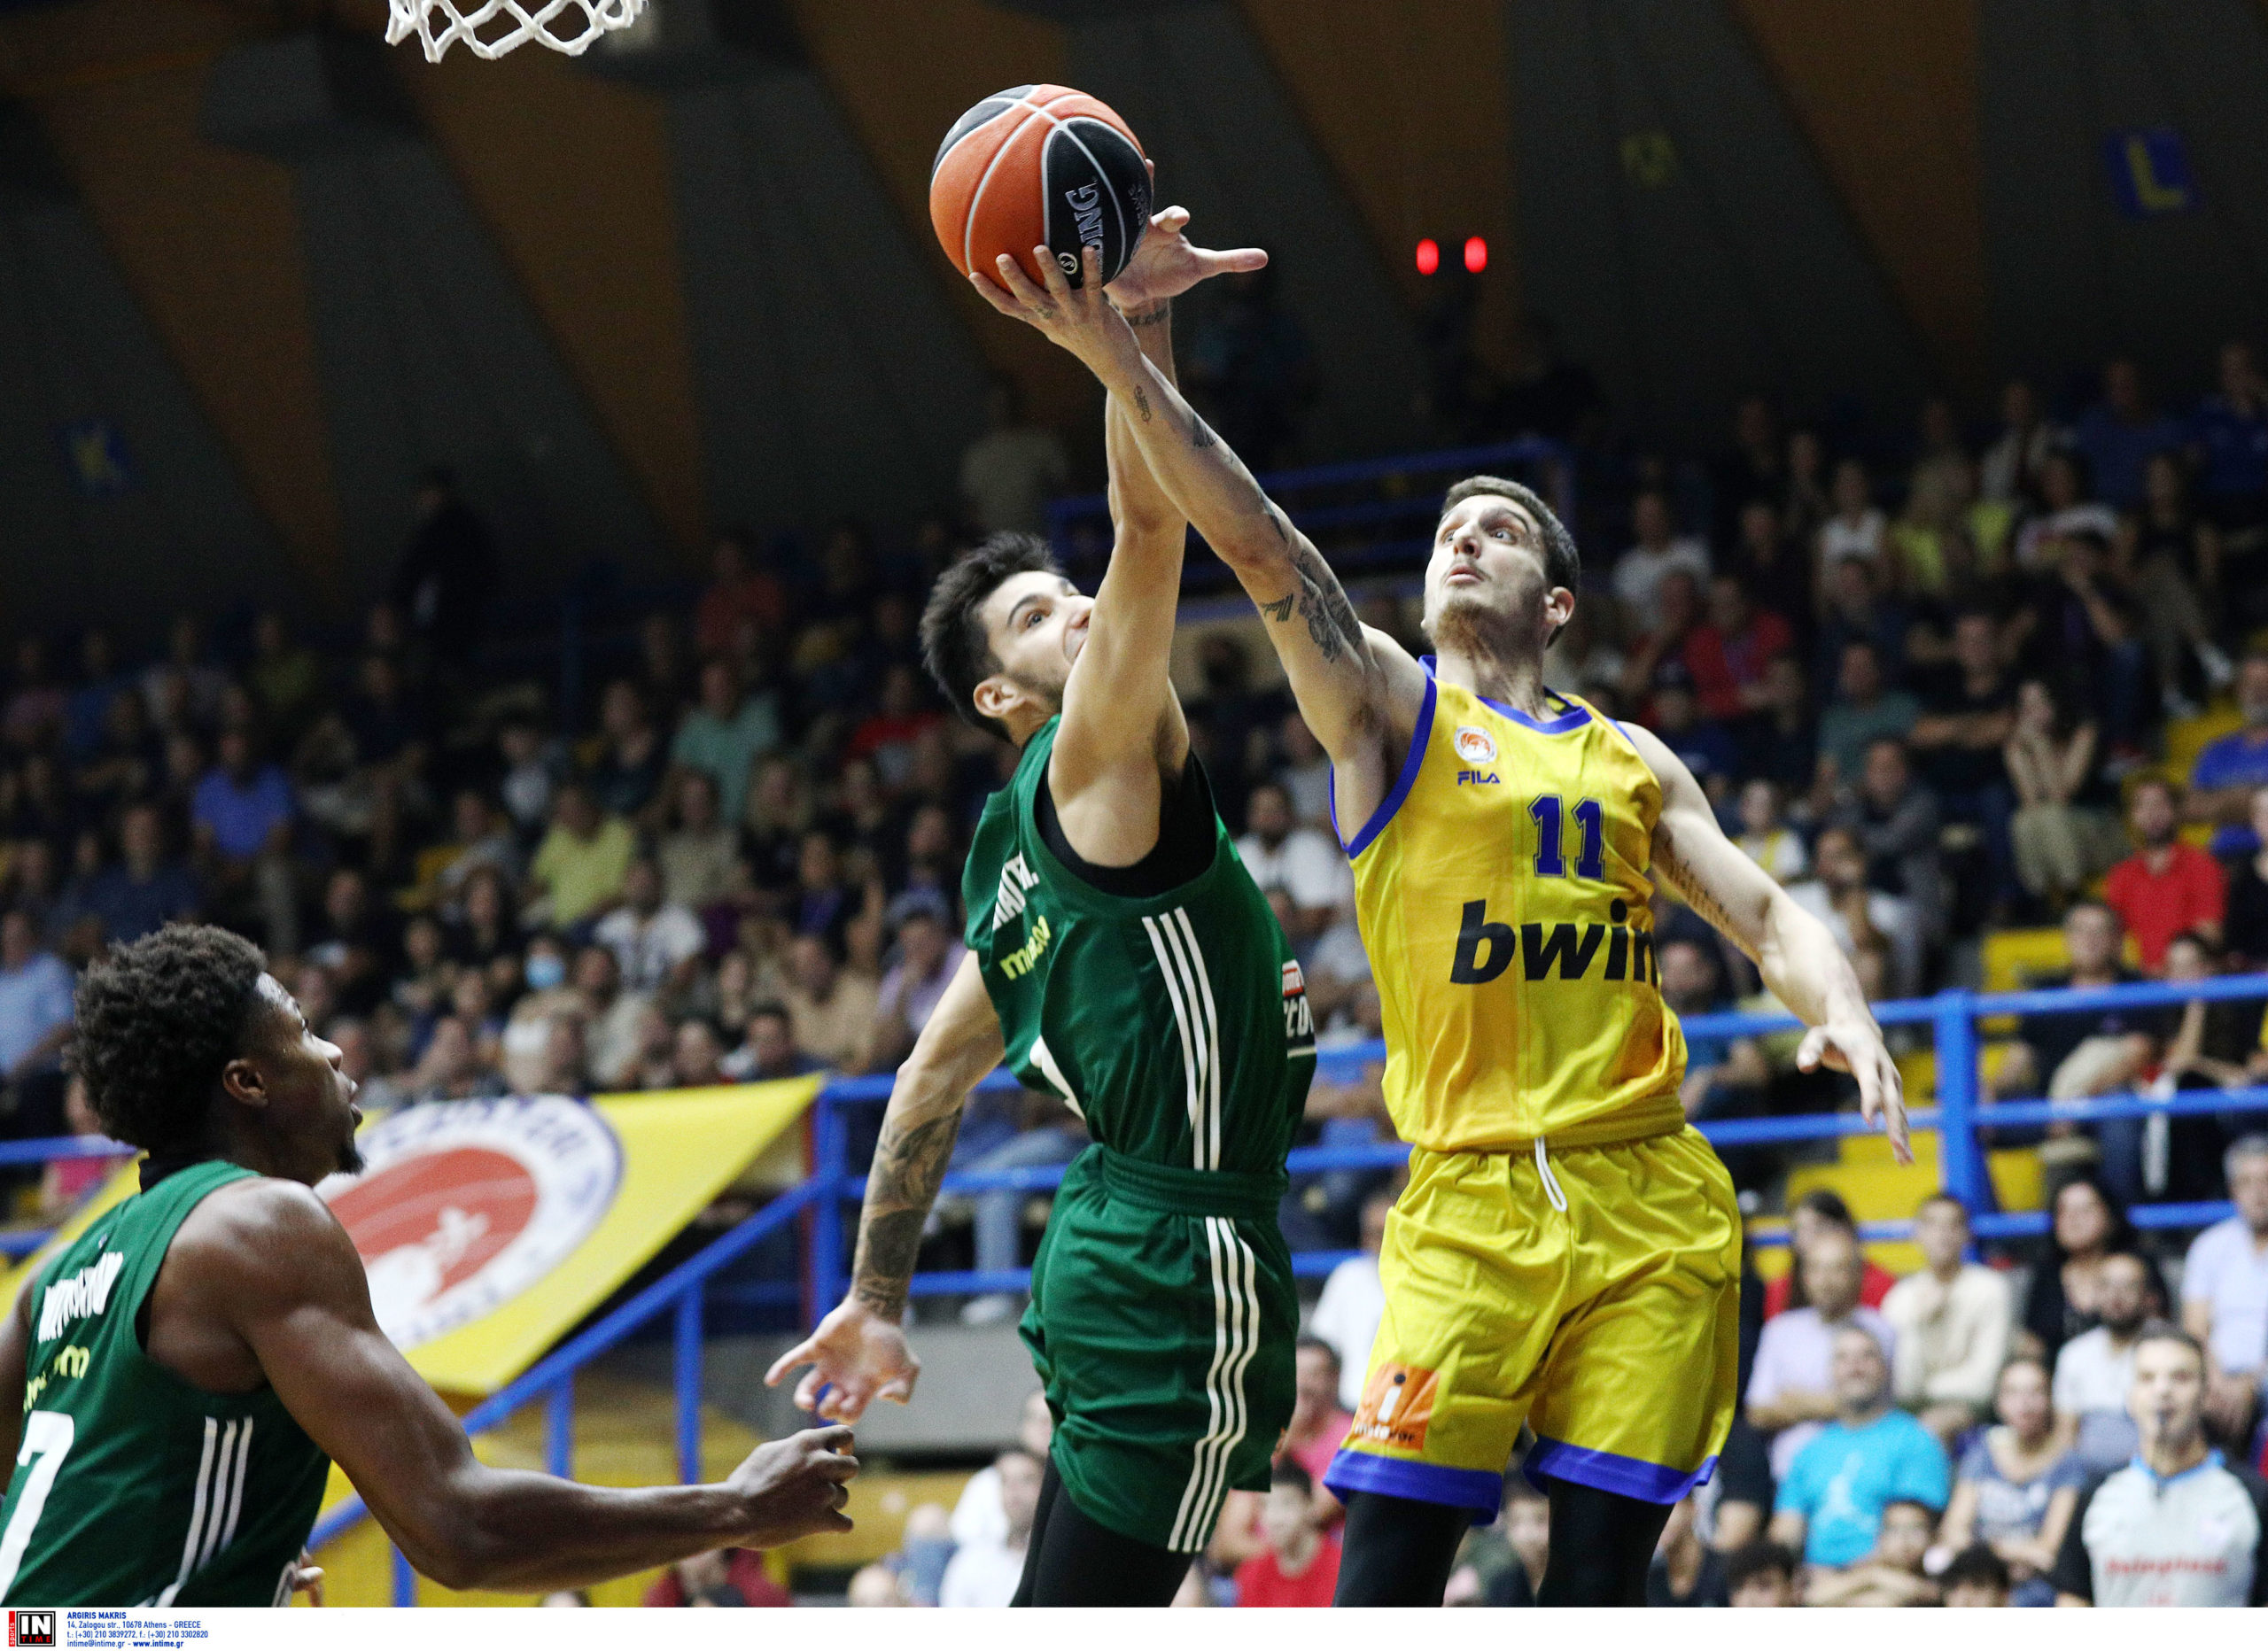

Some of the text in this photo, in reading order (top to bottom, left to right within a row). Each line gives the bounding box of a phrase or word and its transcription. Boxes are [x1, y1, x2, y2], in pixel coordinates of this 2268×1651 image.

[2126, 136, 2186, 210] L
[1457, 771, 1501, 786] FILA
[1527, 794, 1605, 881] 11
[1449, 898, 1657, 988] bwin
